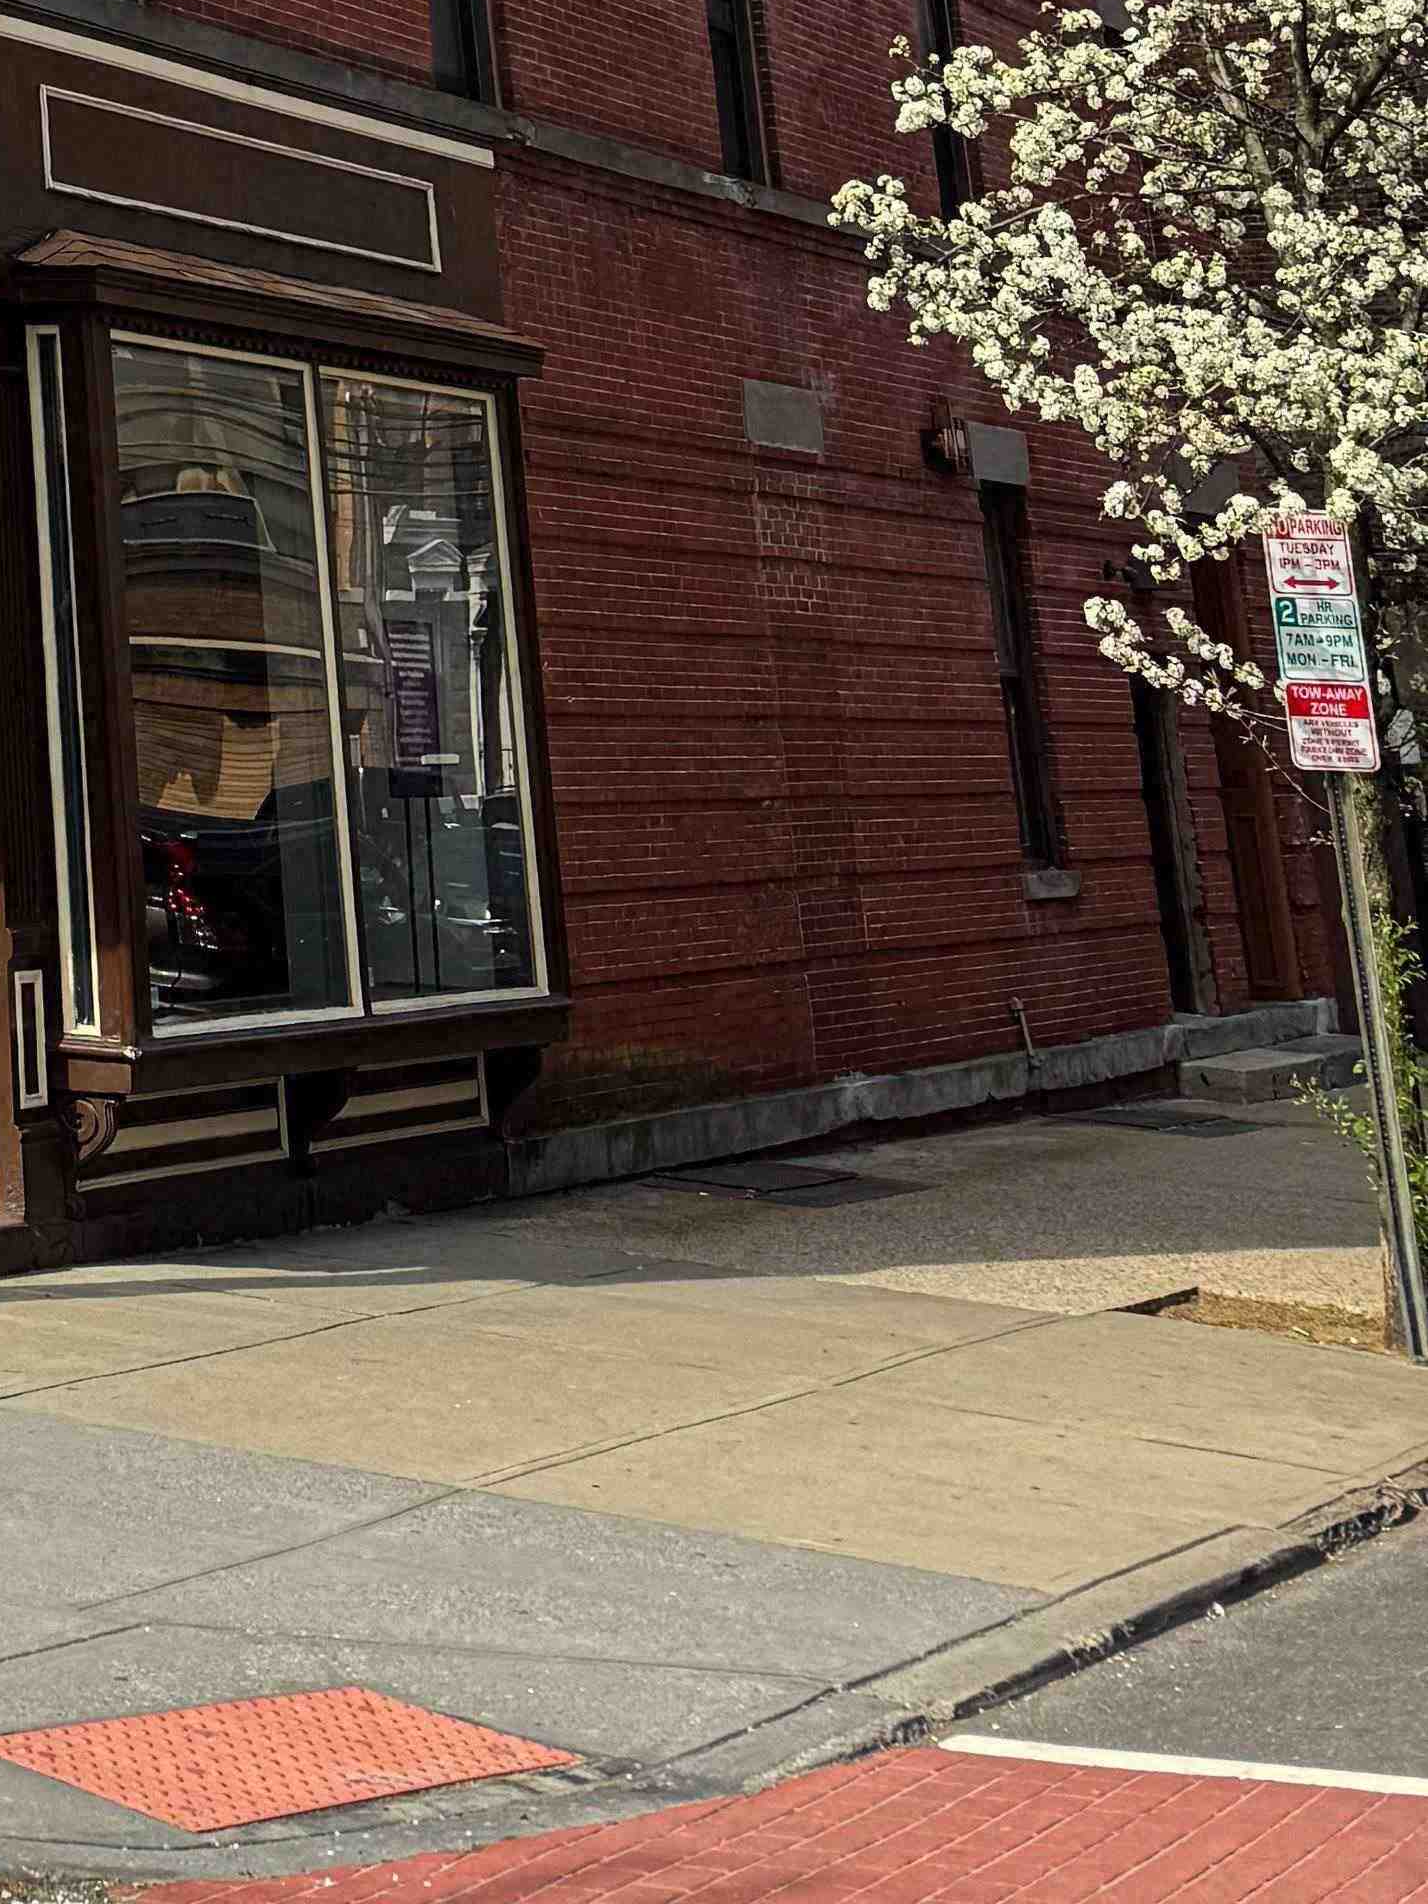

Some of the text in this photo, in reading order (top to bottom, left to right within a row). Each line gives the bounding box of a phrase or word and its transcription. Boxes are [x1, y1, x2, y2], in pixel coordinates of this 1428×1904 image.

[1290, 518, 1342, 536] PARKING
[1279, 542, 1335, 555] TUESDAY
[1279, 558, 1301, 570] 1PM
[1279, 600, 1295, 623] 2
[1316, 601, 1332, 613] HR
[1300, 613, 1353, 626] PARKING
[1290, 685, 1364, 701] TOW-AWAY
[1309, 701, 1348, 717] ZONE
